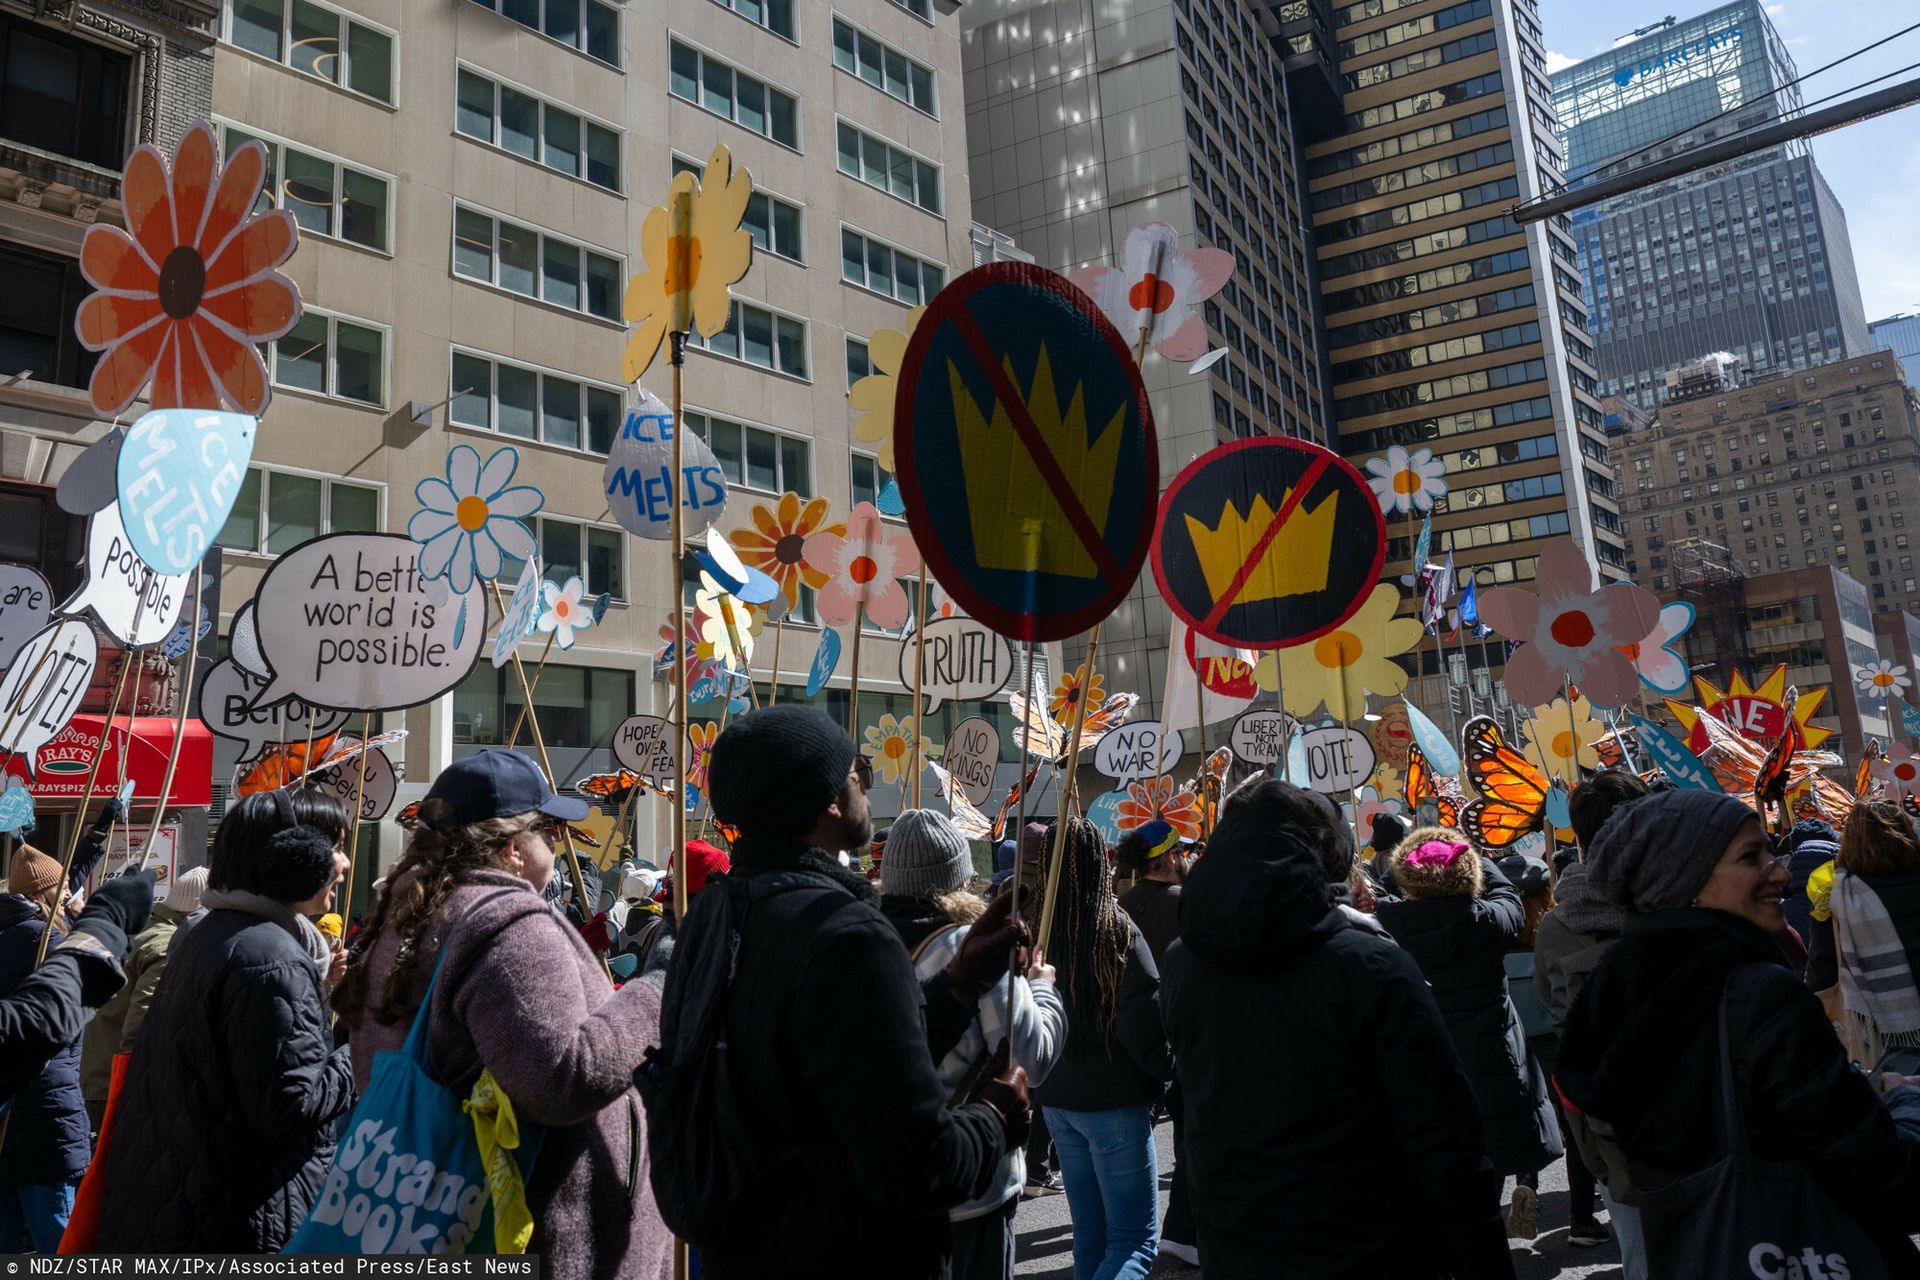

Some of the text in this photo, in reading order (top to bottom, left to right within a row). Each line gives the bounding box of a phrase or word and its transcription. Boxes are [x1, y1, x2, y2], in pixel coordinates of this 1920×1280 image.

[1639, 26, 1745, 78] BARCLAYS
[623, 413, 674, 443] ICE
[194, 415, 240, 508] ICE
[125, 414, 209, 568] MELTS
[607, 465, 726, 522] MELTS
[101, 536, 171, 624] possble
[310, 554, 340, 590] A
[304, 596, 436, 629] world is
[314, 631, 451, 682] possible.
[911, 630, 997, 686] TRUTH
[622, 724, 660, 744] HOPE
[963, 728, 989, 754] NO
[1116, 730, 1157, 751] NO
[1241, 719, 1295, 736] LIBERTY
[1255, 735, 1278, 745] NOT
[43, 747, 93, 763] RAY'S
[635, 740, 669, 756] OVER
[651, 756, 675, 772] FEA
[1242, 742, 1284, 757] TYRAN
[945, 753, 992, 788] KINGS
[339, 1118, 491, 1232] Strand
[309, 1164, 476, 1254] Books
[1748, 1242, 1852, 1280] Cats
